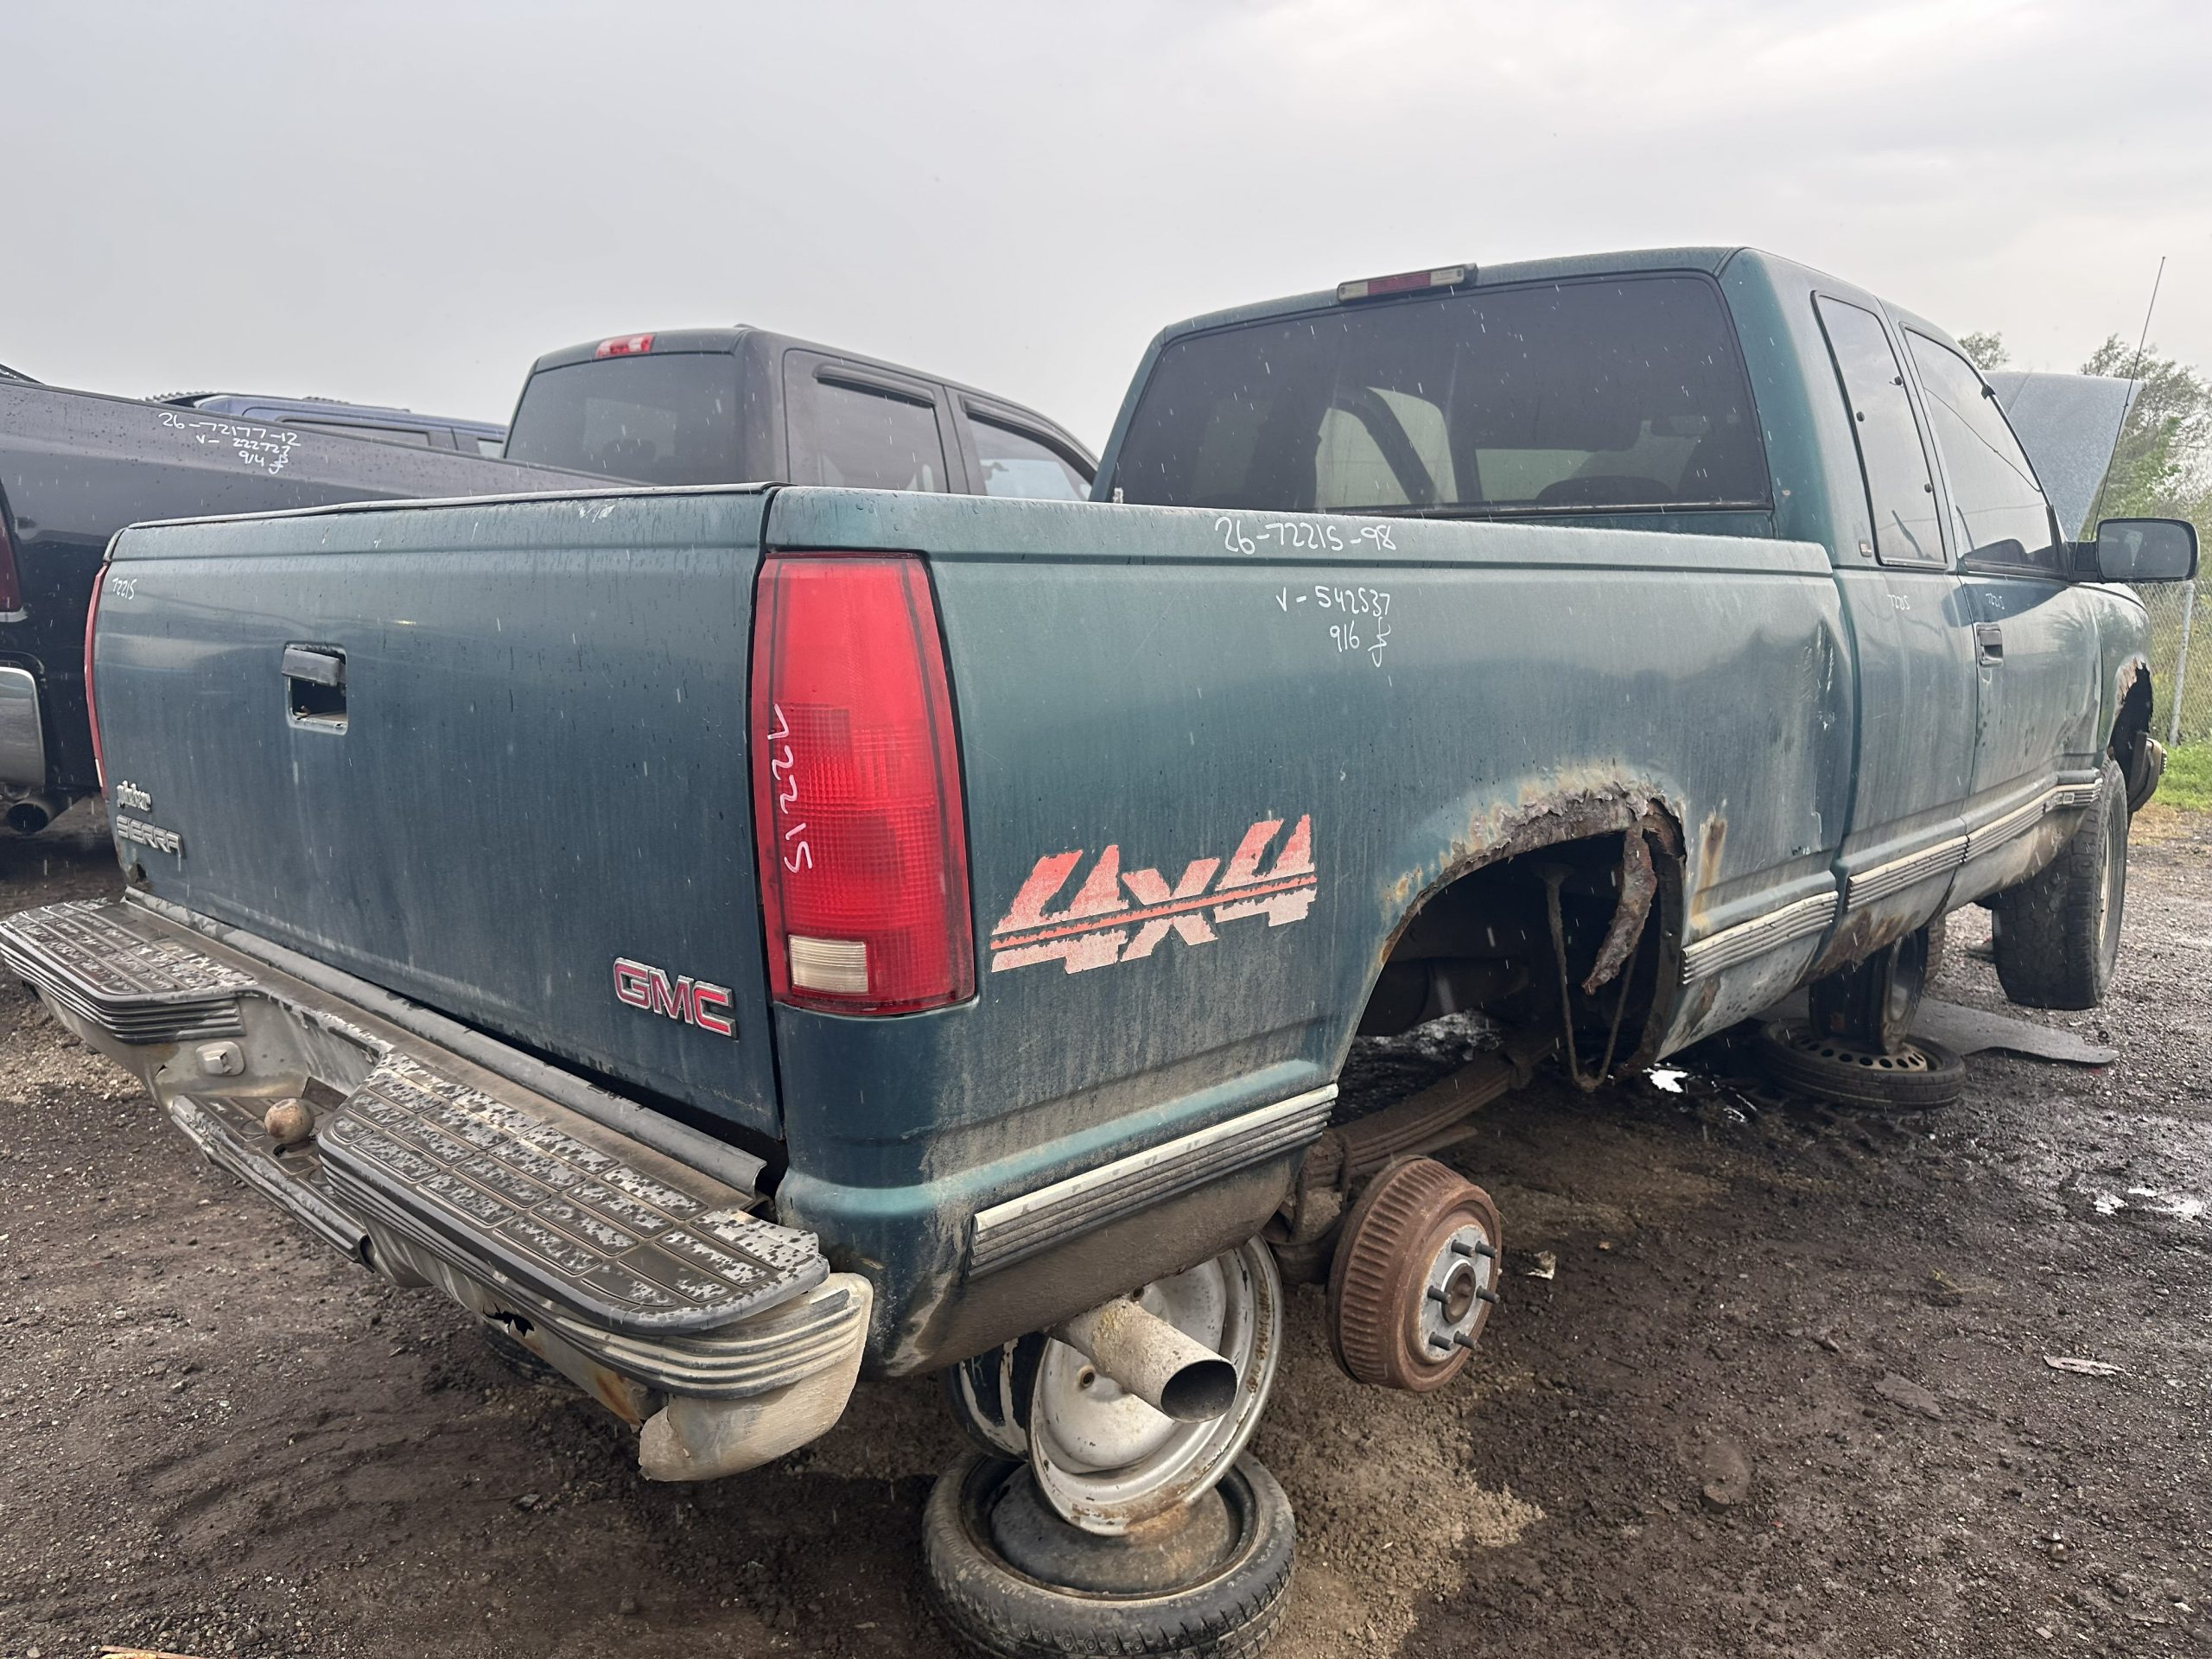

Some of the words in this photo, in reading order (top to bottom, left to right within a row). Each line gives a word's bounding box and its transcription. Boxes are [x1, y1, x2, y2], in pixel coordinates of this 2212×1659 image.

[157, 412, 302, 447] 26-72177-12
[238, 450, 264, 467] 914
[1214, 516, 1397, 556] 26-72215-98
[111, 576, 137, 601] 72215
[1329, 620, 1360, 652] 916
[766, 702, 813, 874] 72215
[116, 814, 187, 859] SIERRA
[613, 957, 738, 1039] GMC
